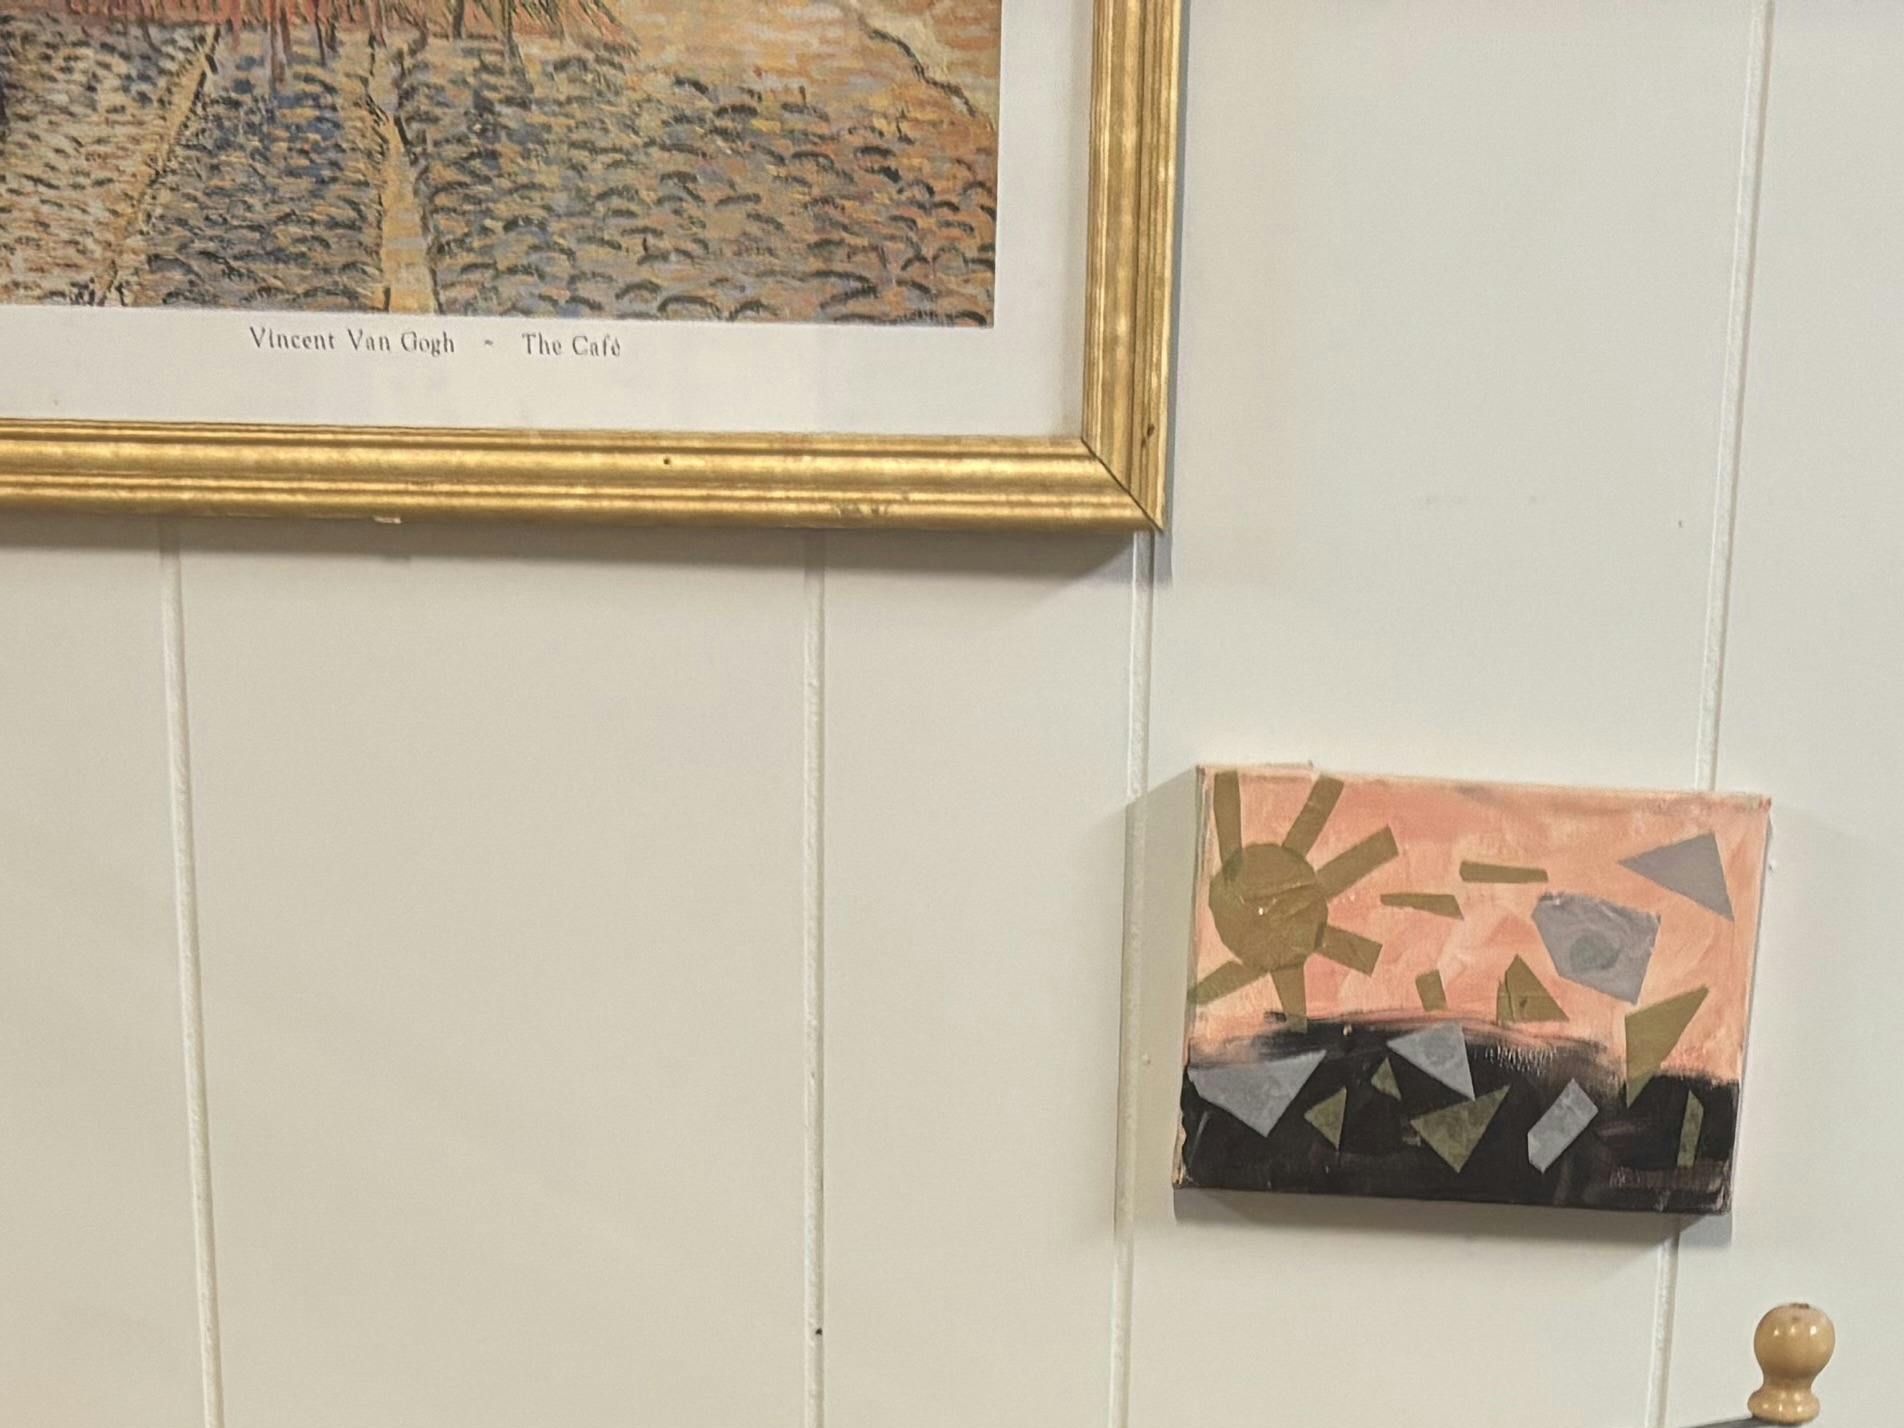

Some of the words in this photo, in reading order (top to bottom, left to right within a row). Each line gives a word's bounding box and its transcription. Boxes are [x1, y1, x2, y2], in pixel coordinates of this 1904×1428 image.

[250, 326, 335, 350] Vincent
[348, 328, 391, 351] Van
[400, 329, 455, 357] Gogh
[521, 332, 562, 355] The
